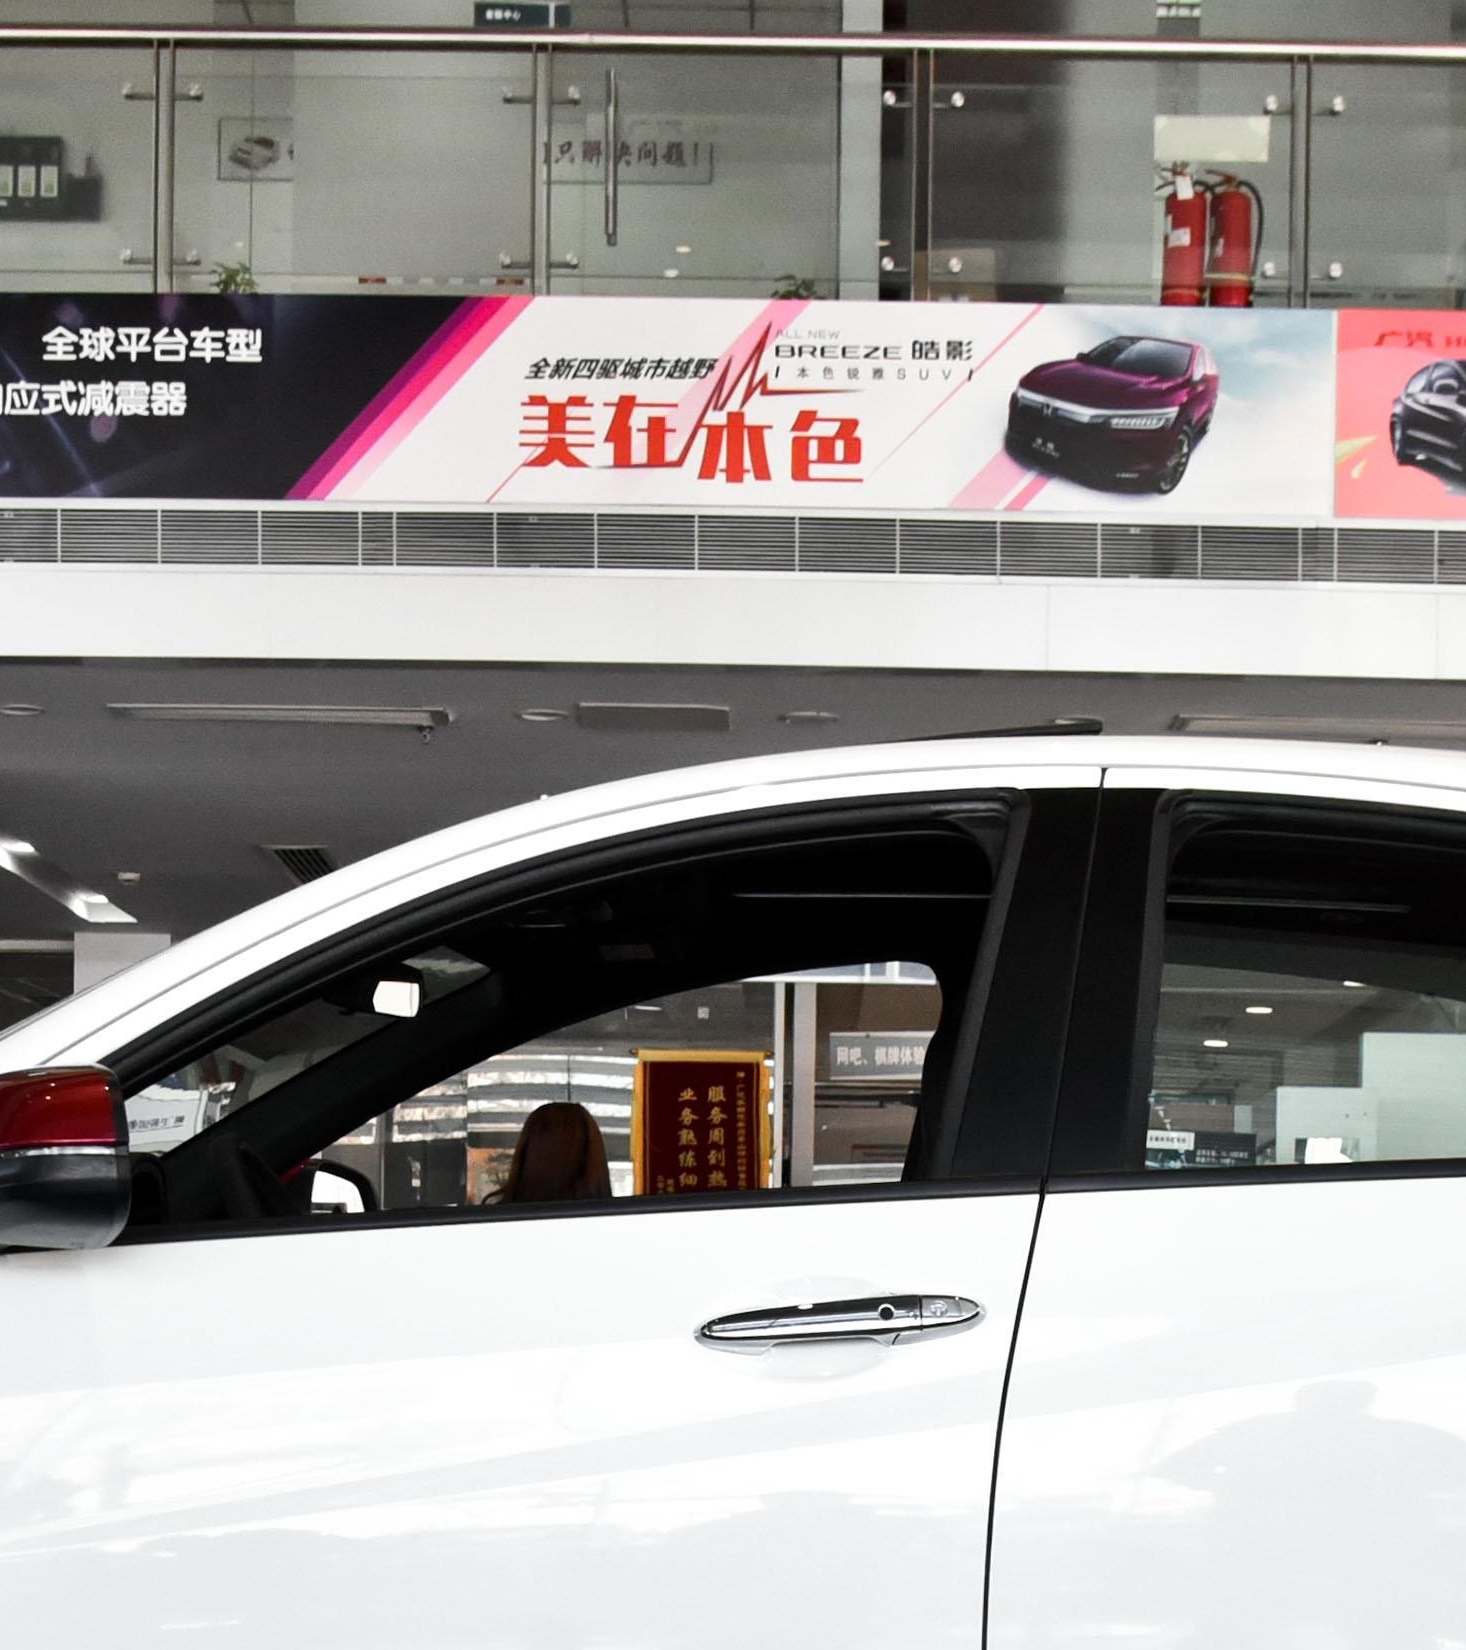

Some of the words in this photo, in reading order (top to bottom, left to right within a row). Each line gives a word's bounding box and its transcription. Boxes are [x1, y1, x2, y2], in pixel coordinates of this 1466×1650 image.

[42, 326, 263, 364] 全球平台车型
[775, 345, 903, 359] BREEZE
[912, 340, 973, 361] 皓影
[525, 357, 716, 382] 全新四驱城市越野
[519, 393, 864, 484] 美在本色
